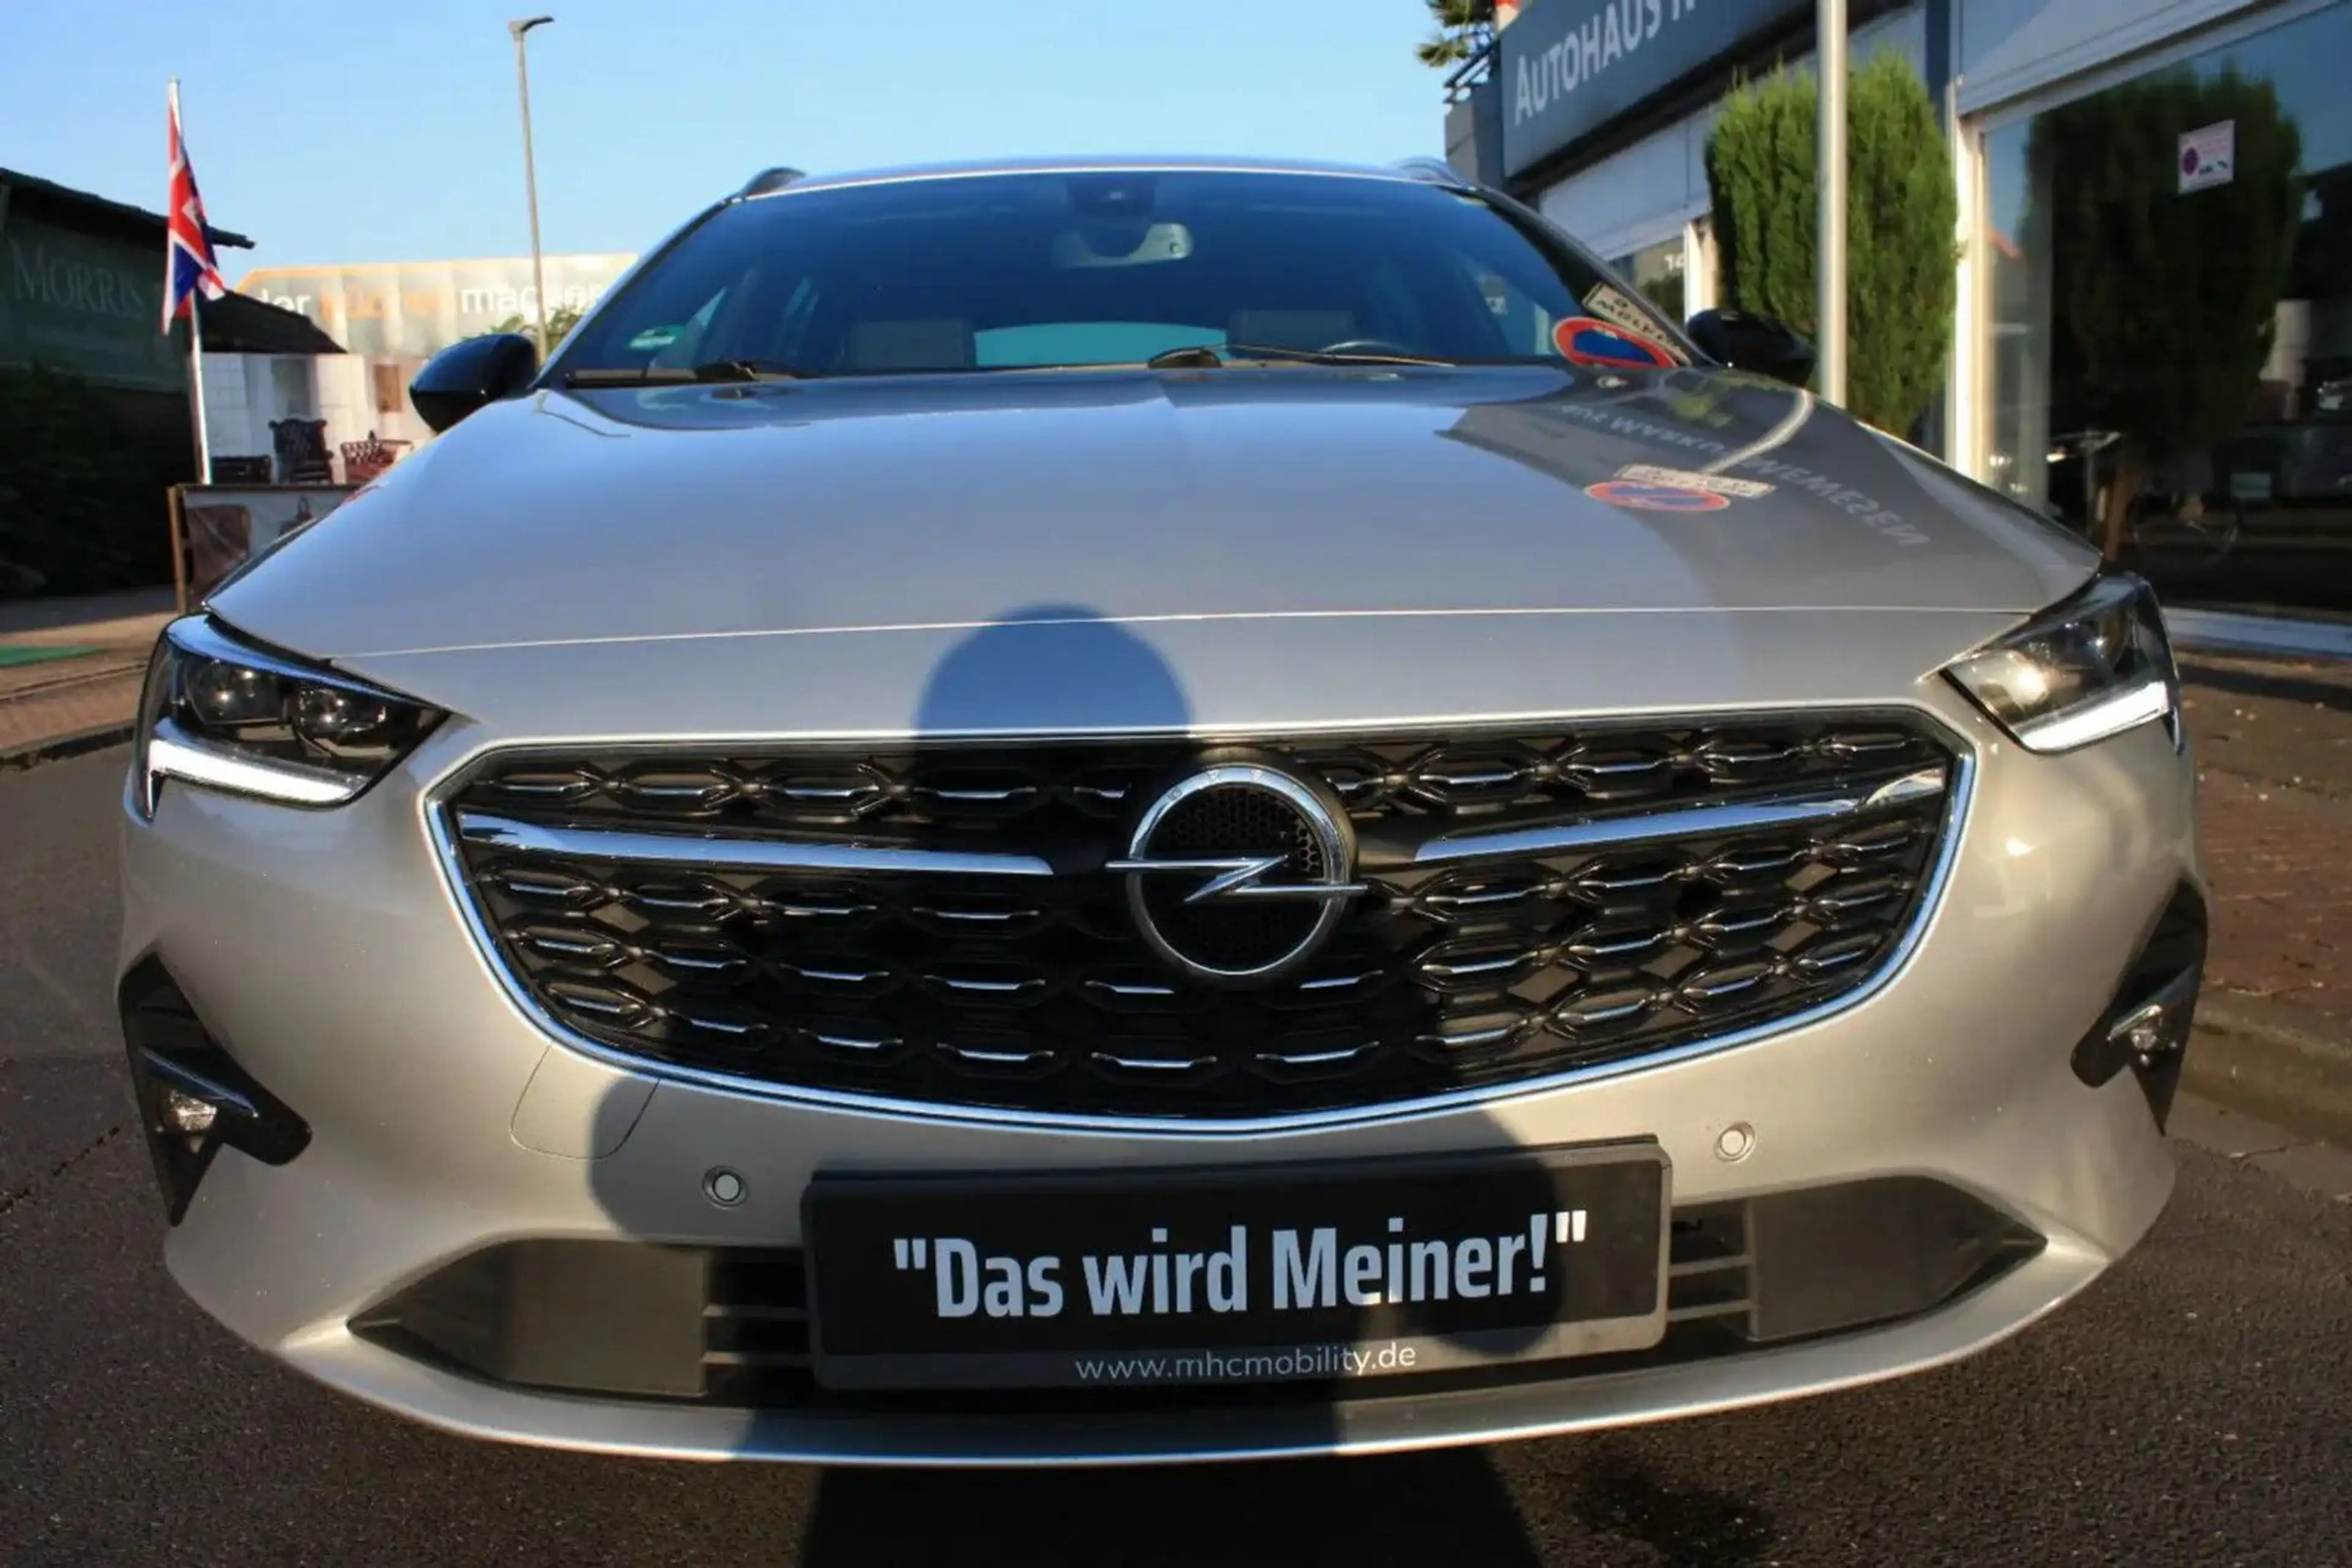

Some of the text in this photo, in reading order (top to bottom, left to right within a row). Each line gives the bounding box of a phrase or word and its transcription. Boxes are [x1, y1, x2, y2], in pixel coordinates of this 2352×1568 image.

[1515, 0, 1662, 127] AUTOHAUS
[8, 238, 146, 321] MORRIS
[894, 1210, 1587, 1317] "Das wird Meiner!"
[1075, 1341, 1417, 1379] www.mhcmobility.de
